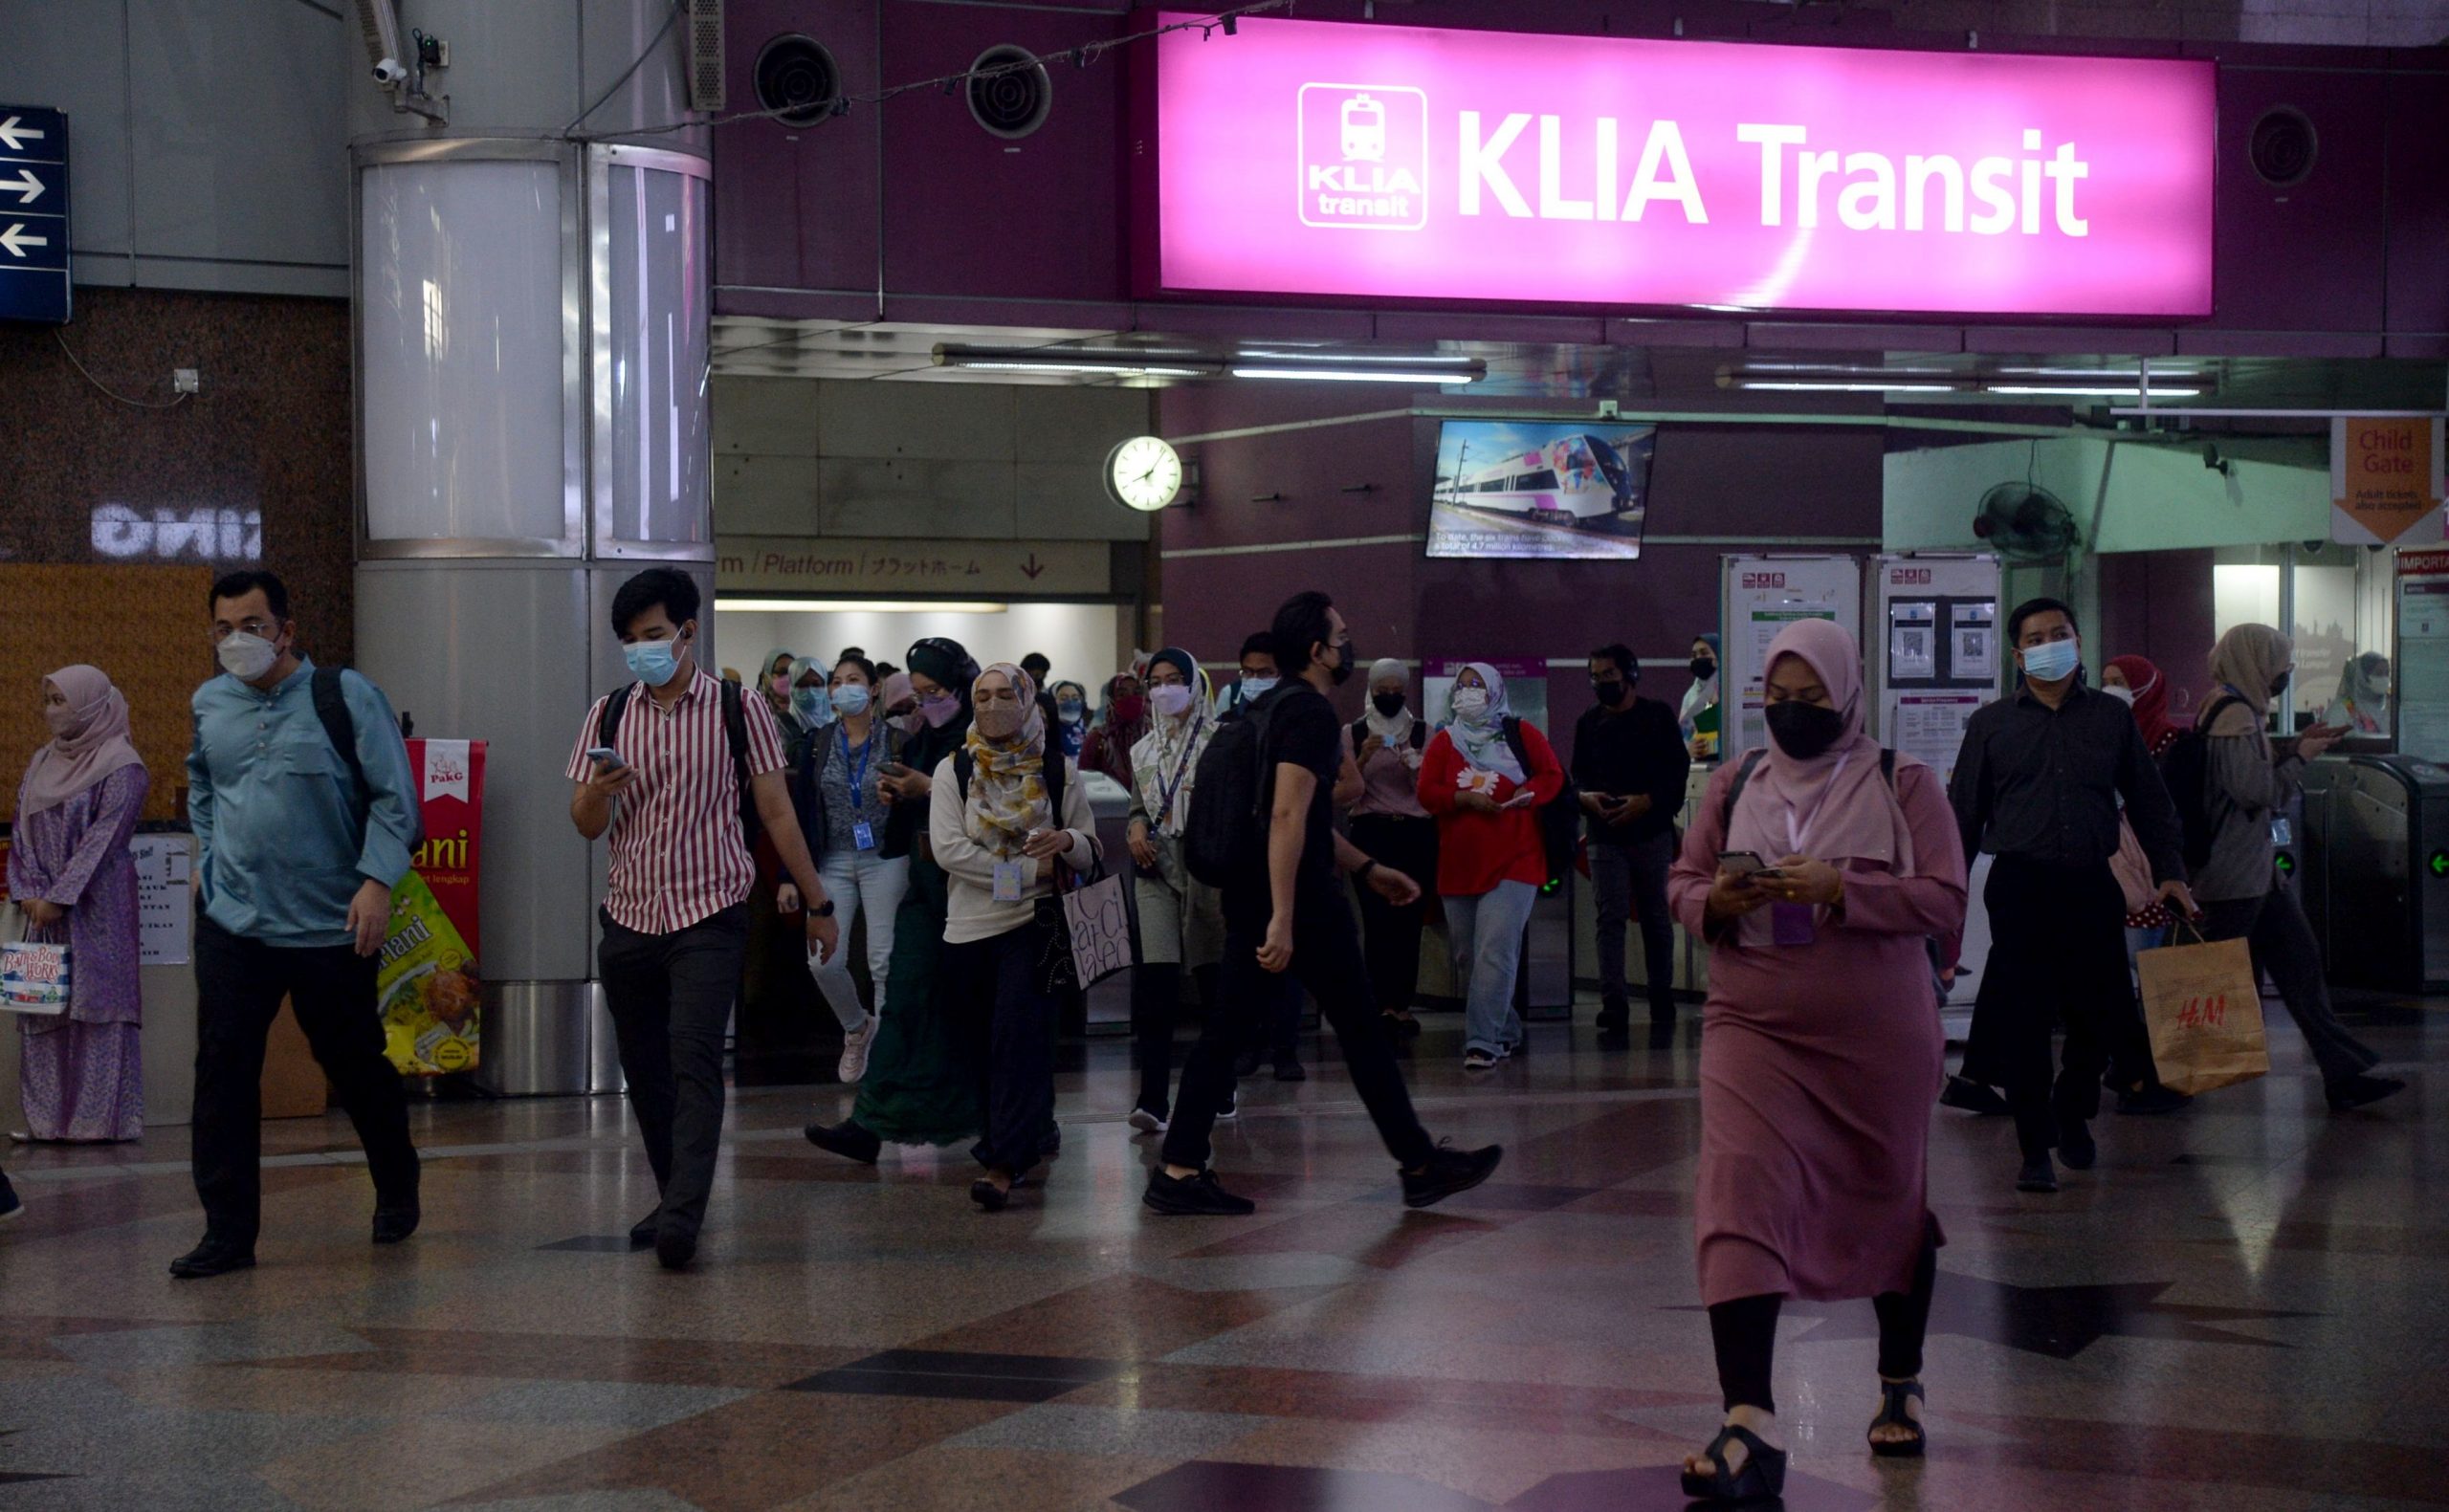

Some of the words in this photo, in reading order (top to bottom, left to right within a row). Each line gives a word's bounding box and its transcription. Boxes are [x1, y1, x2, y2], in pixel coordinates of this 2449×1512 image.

[1309, 164, 1422, 194] KLIA
[1459, 110, 1710, 224] KLIA
[1736, 122, 2088, 236] Transit
[1318, 193, 1409, 218] transit
[2359, 428, 2413, 450] Child
[2363, 453, 2415, 473] Gate
[763, 553, 853, 575] Platform
[430, 772, 463, 783] PakG
[409, 828, 469, 869] ani
[432, 873, 470, 886] lengkap
